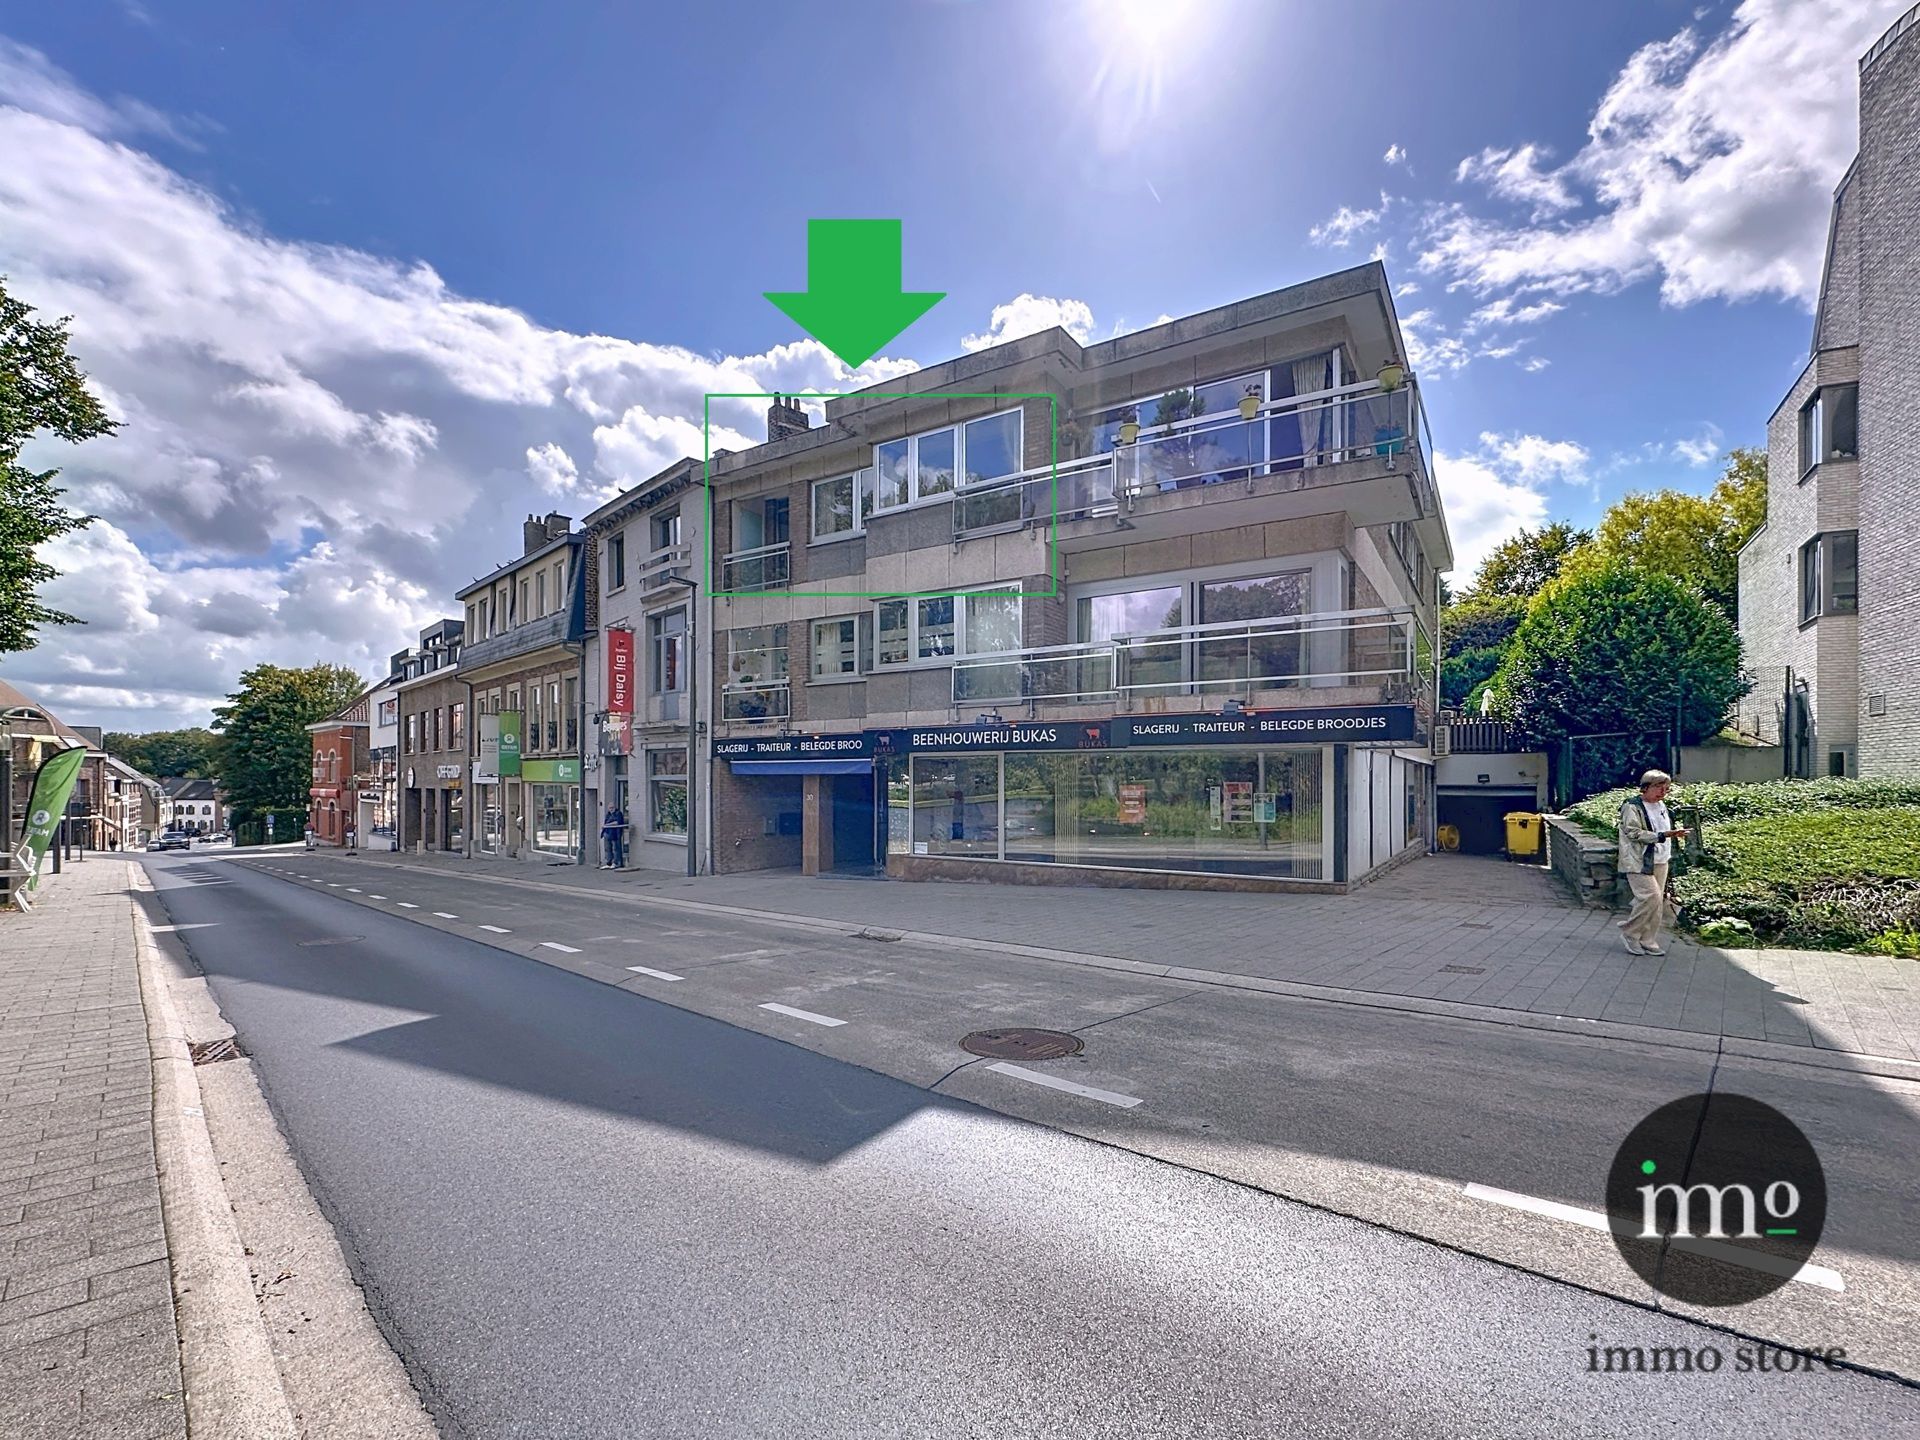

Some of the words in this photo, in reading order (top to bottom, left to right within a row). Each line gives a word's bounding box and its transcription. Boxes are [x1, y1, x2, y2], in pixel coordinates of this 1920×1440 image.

[613, 674, 626, 707] Daisy
[1132, 723, 1180, 735] SLAGERIJ
[1192, 721, 1245, 733] TRAITEUR
[1260, 719, 1314, 731] BELEGDE
[1317, 717, 1386, 730] BROODJES
[912, 731, 1009, 746] BEENHOUWERIJ
[1012, 728, 1057, 743] BUKAS
[1078, 740, 1109, 748] BUKAS
[717, 743, 749, 754] SLAGERIJ
[756, 742, 791, 752] TRAITEUR
[800, 740, 836, 751] BELEGDE
[837, 739, 863, 749] BROO
[873, 745, 896, 753] BUKAS
